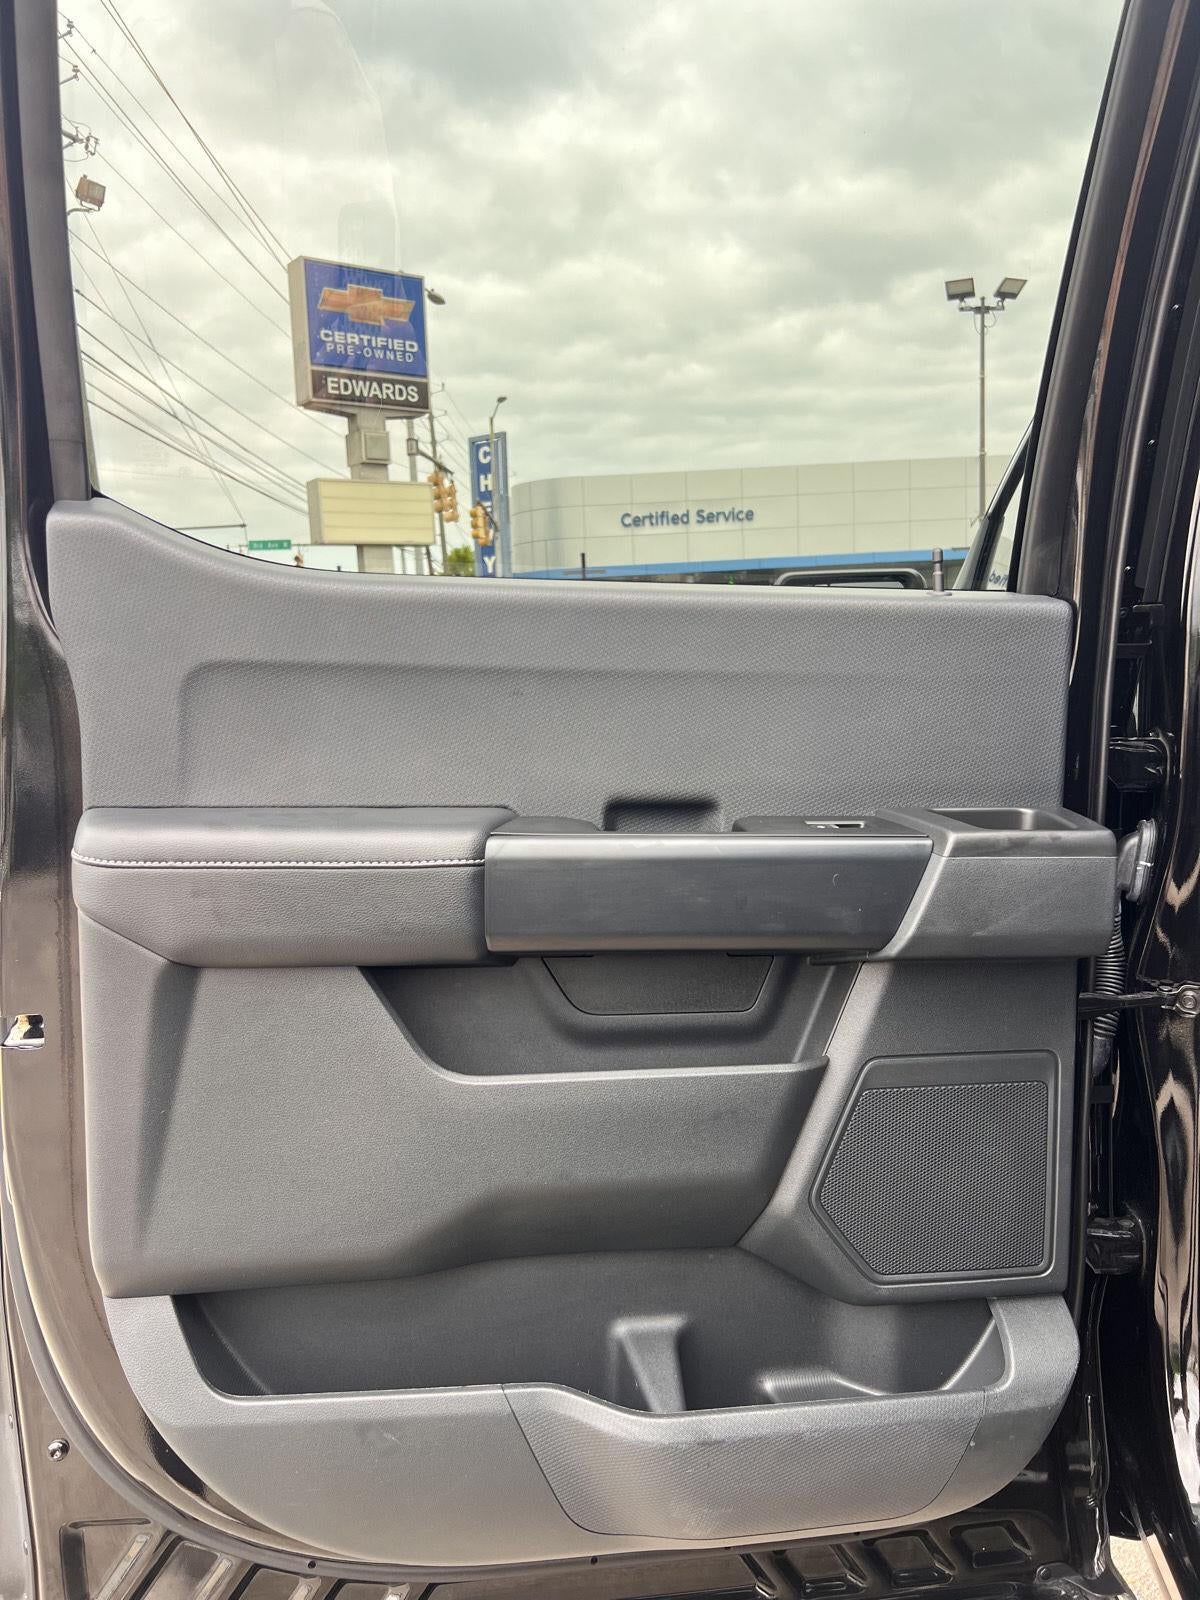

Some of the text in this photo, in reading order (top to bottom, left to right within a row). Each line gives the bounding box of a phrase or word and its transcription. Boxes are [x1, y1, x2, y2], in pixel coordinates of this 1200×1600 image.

[320, 330, 419, 352] CERTIFIED
[326, 344, 414, 362] PRE-OWNED
[327, 378, 419, 402] EDWARDS
[621, 507, 755, 528] Certified Service
